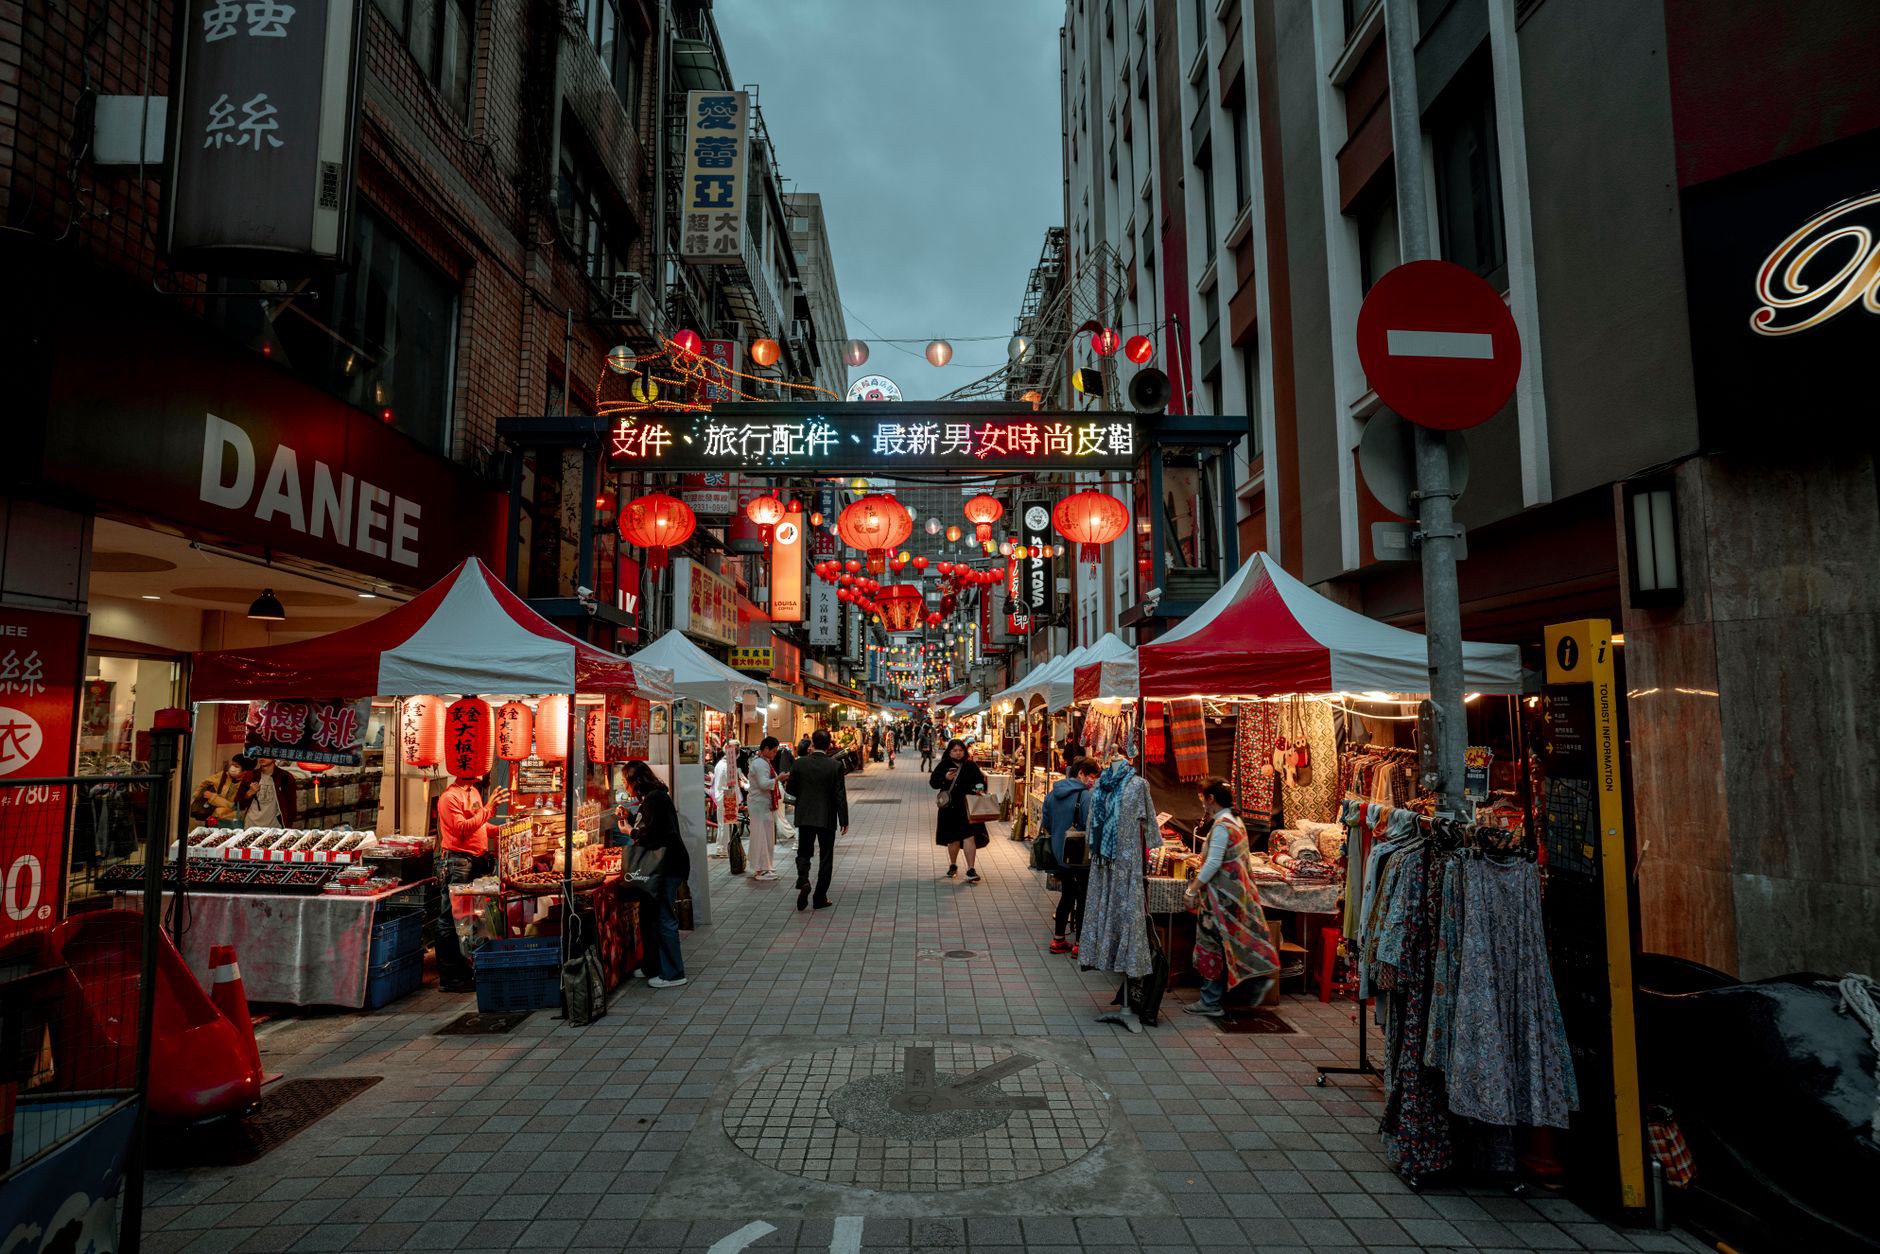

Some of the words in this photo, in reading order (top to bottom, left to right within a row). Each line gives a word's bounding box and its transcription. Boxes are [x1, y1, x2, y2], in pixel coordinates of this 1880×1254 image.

[199, 412, 422, 568] DANEE
[0, 625, 28, 637] EE
[256, 701, 358, 750] 櫻桃
[1599, 684, 1609, 723] TOURIST
[1602, 725, 1613, 792] INFORMATION
